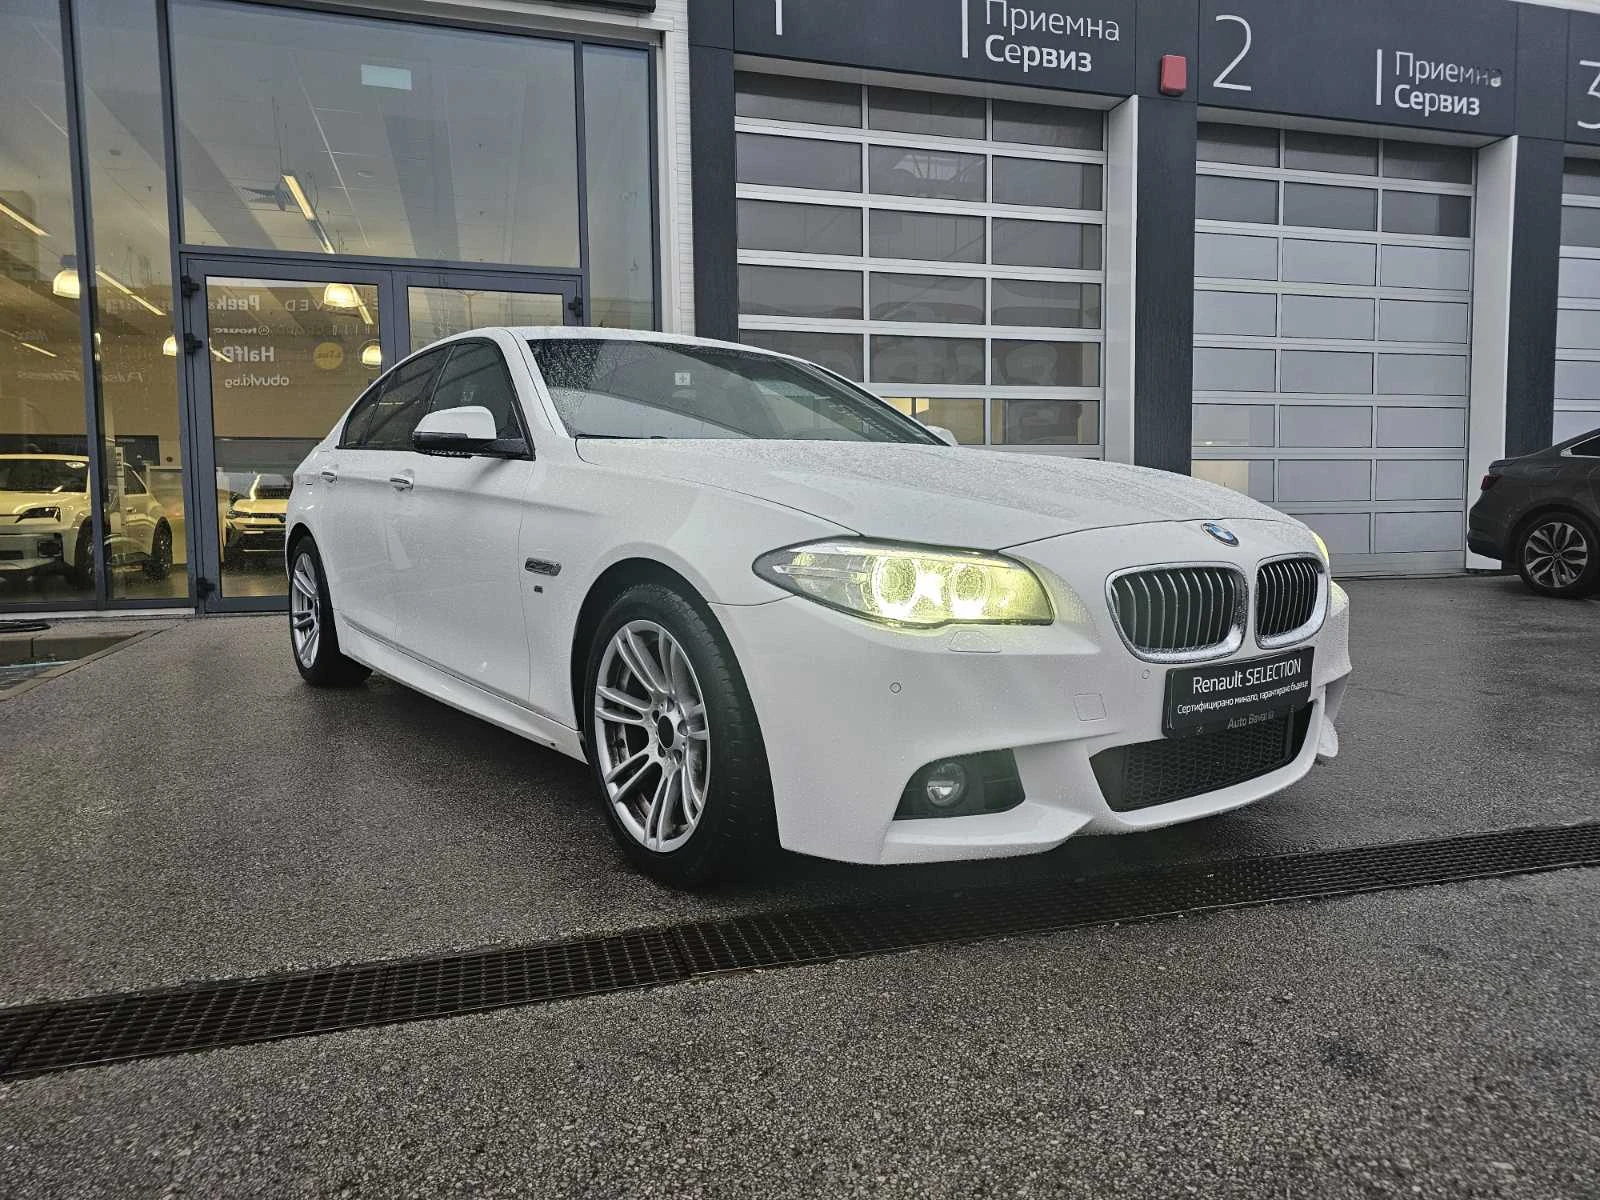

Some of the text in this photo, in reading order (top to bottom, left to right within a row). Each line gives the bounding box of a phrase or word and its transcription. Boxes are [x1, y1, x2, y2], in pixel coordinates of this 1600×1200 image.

[986, 0, 1120, 41] Приемна
[985, 34, 1092, 73] Сервиз
[1213, 14, 1252, 92] 2
[1395, 51, 1502, 88] Приемна
[1394, 84, 1480, 117] Сервиз
[1192, 658, 1302, 695] Renault SELECTION
[1177, 698, 1234, 715] Сертифицирано
[1227, 716, 1247, 730] Auto
